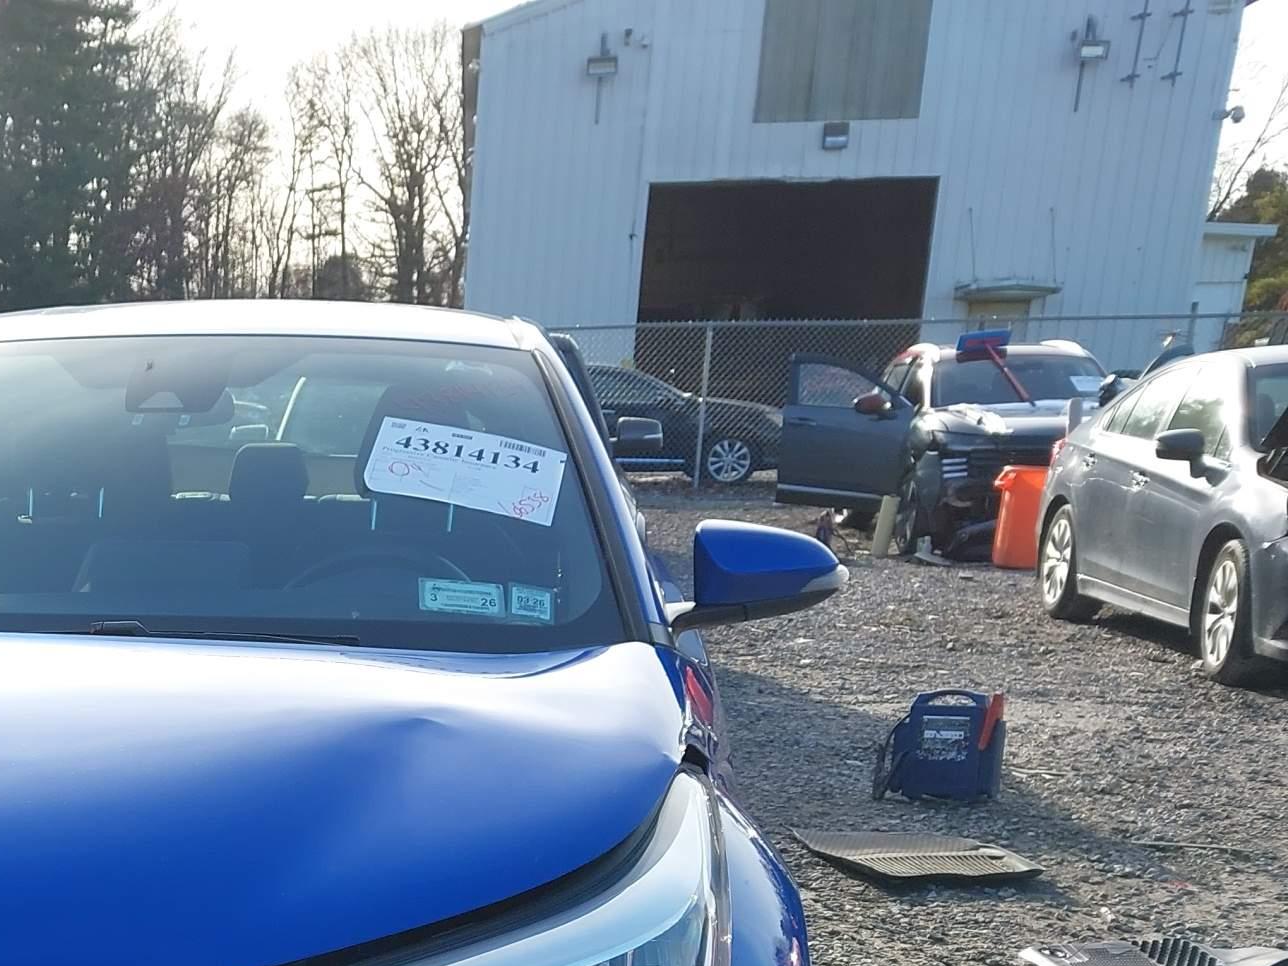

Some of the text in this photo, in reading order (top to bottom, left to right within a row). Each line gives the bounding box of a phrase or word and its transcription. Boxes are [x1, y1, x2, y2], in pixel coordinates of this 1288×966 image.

[394, 435, 540, 474] 43814134
[430, 593, 438, 602] 3
[480, 597, 497, 608] 26
